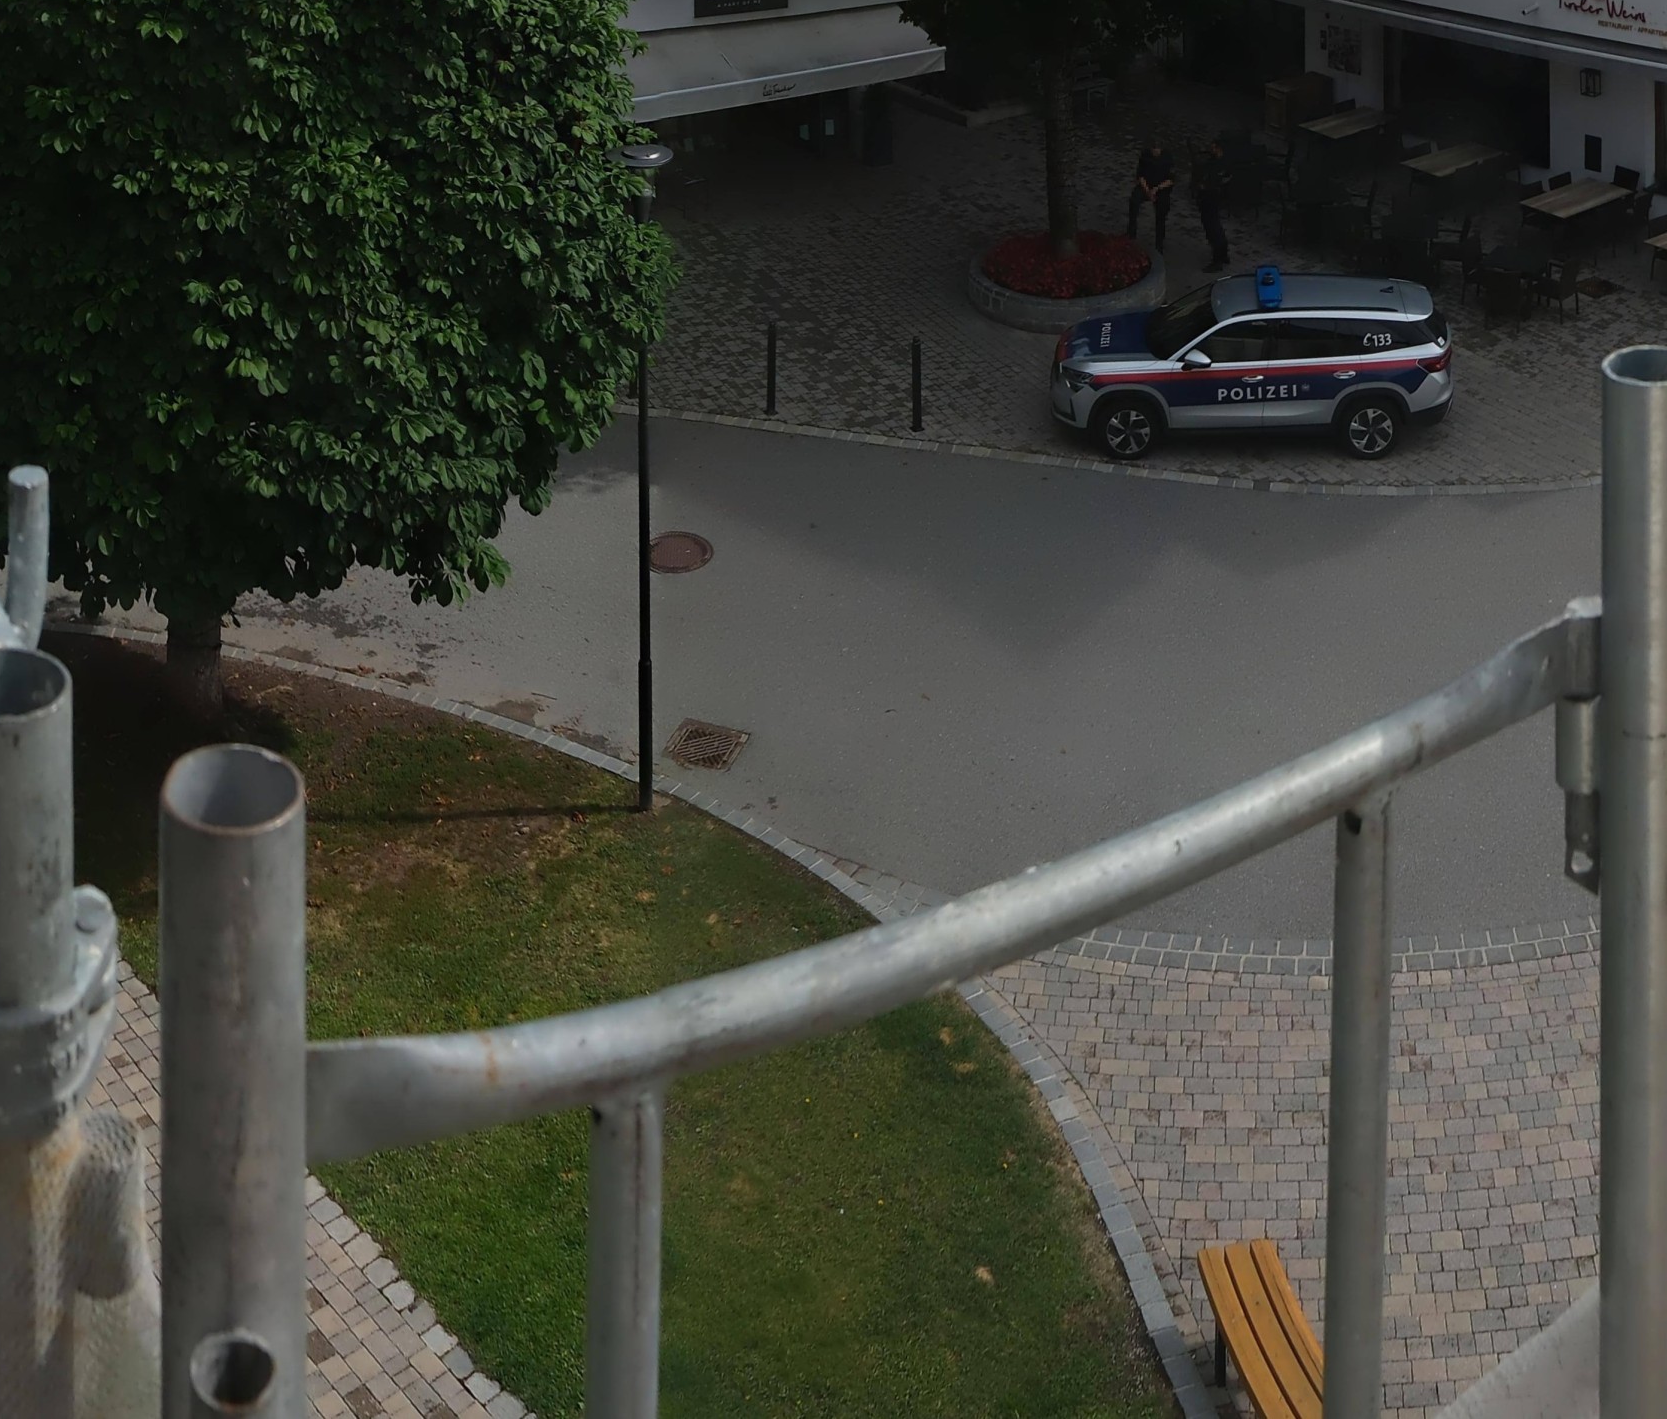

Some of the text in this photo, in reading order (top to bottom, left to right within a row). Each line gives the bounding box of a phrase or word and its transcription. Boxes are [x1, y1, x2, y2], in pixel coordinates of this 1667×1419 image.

[1598, 20, 1633, 32] RESTAURANT
[1100, 322, 1112, 348] POLIZEI
[1372, 333, 1392, 347] 133
[1217, 384, 1297, 401] POLIZEI
